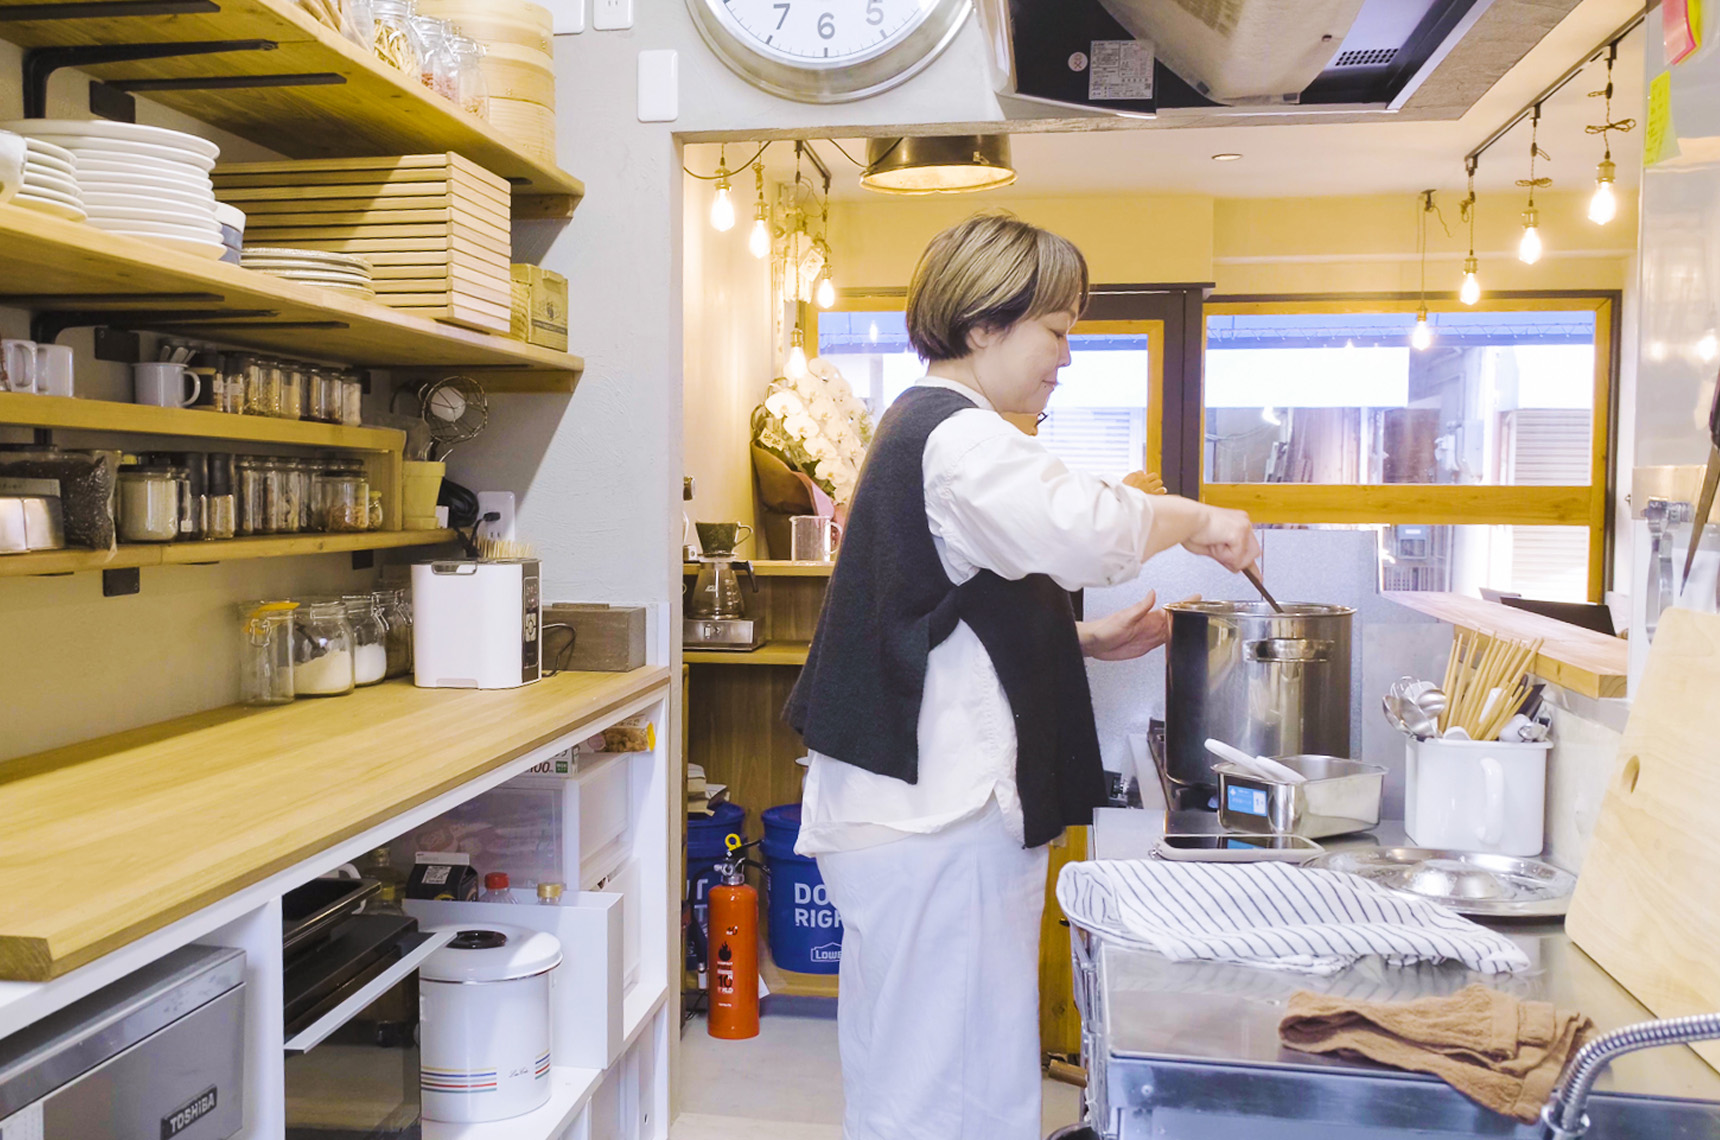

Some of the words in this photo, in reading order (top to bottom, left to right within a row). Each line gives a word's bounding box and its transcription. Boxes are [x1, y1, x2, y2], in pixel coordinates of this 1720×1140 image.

[773, 3, 791, 30] 7
[817, 12, 836, 40] 6
[865, 0, 884, 26] 5
[794, 882, 830, 906] DO
[794, 907, 842, 929] RIGH
[815, 950, 843, 960] LOWE
[169, 1092, 215, 1133] TOSHIBA
